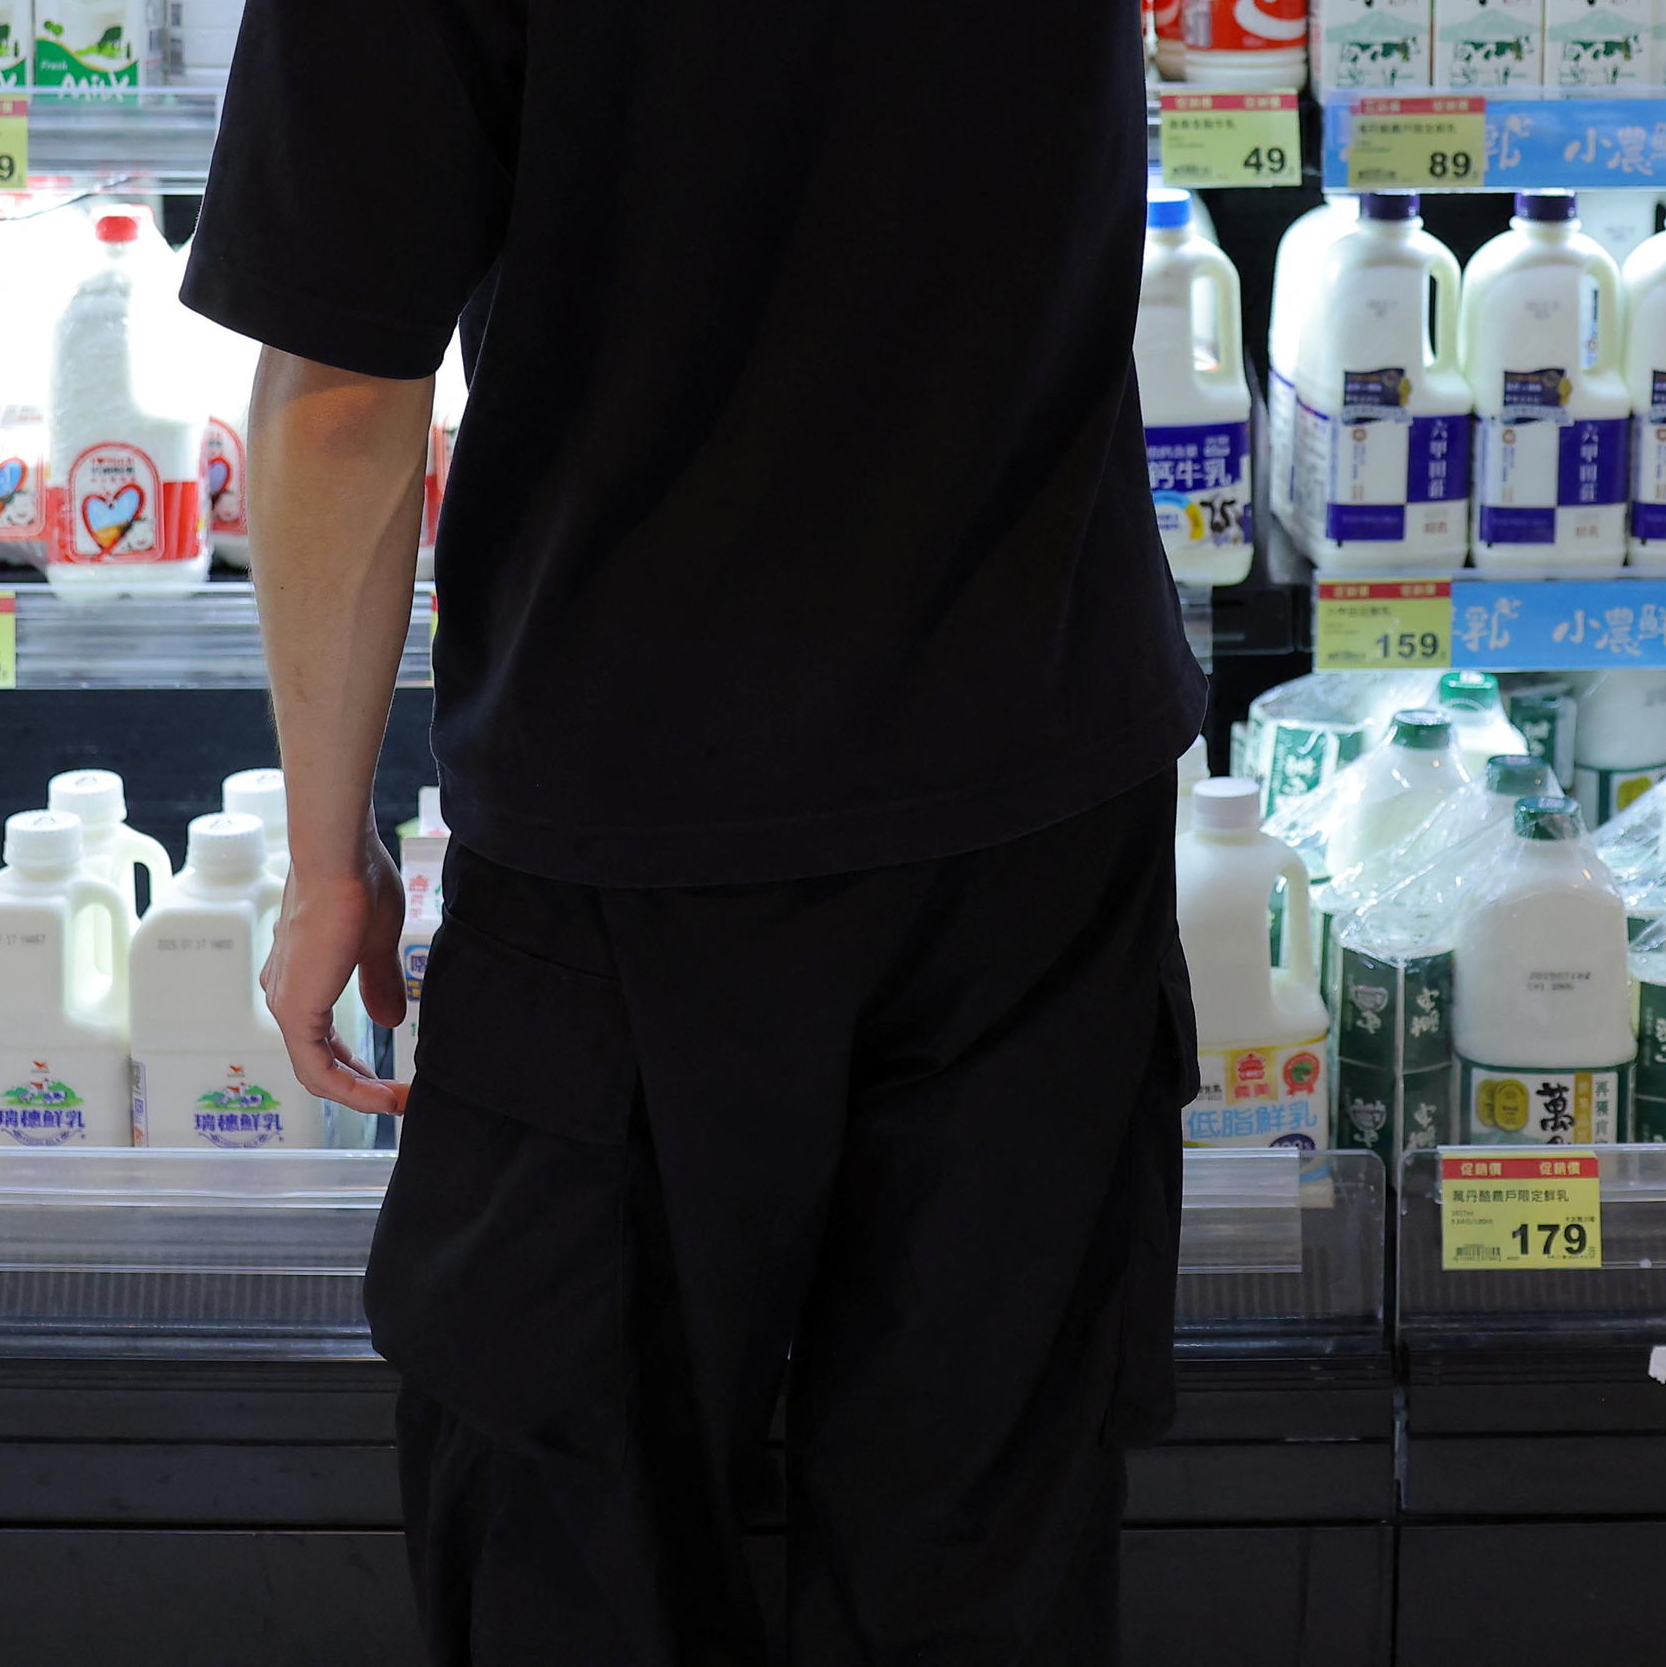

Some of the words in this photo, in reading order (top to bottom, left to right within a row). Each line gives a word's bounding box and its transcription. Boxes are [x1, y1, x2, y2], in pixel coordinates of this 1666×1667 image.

[1243, 147, 1286, 174] 49
[1430, 152, 1471, 179] 89
[1376, 634, 1438, 659] 159
[1188, 1099, 1318, 1140] 低脂鮮乳
[1512, 1224, 1587, 1255] 179
